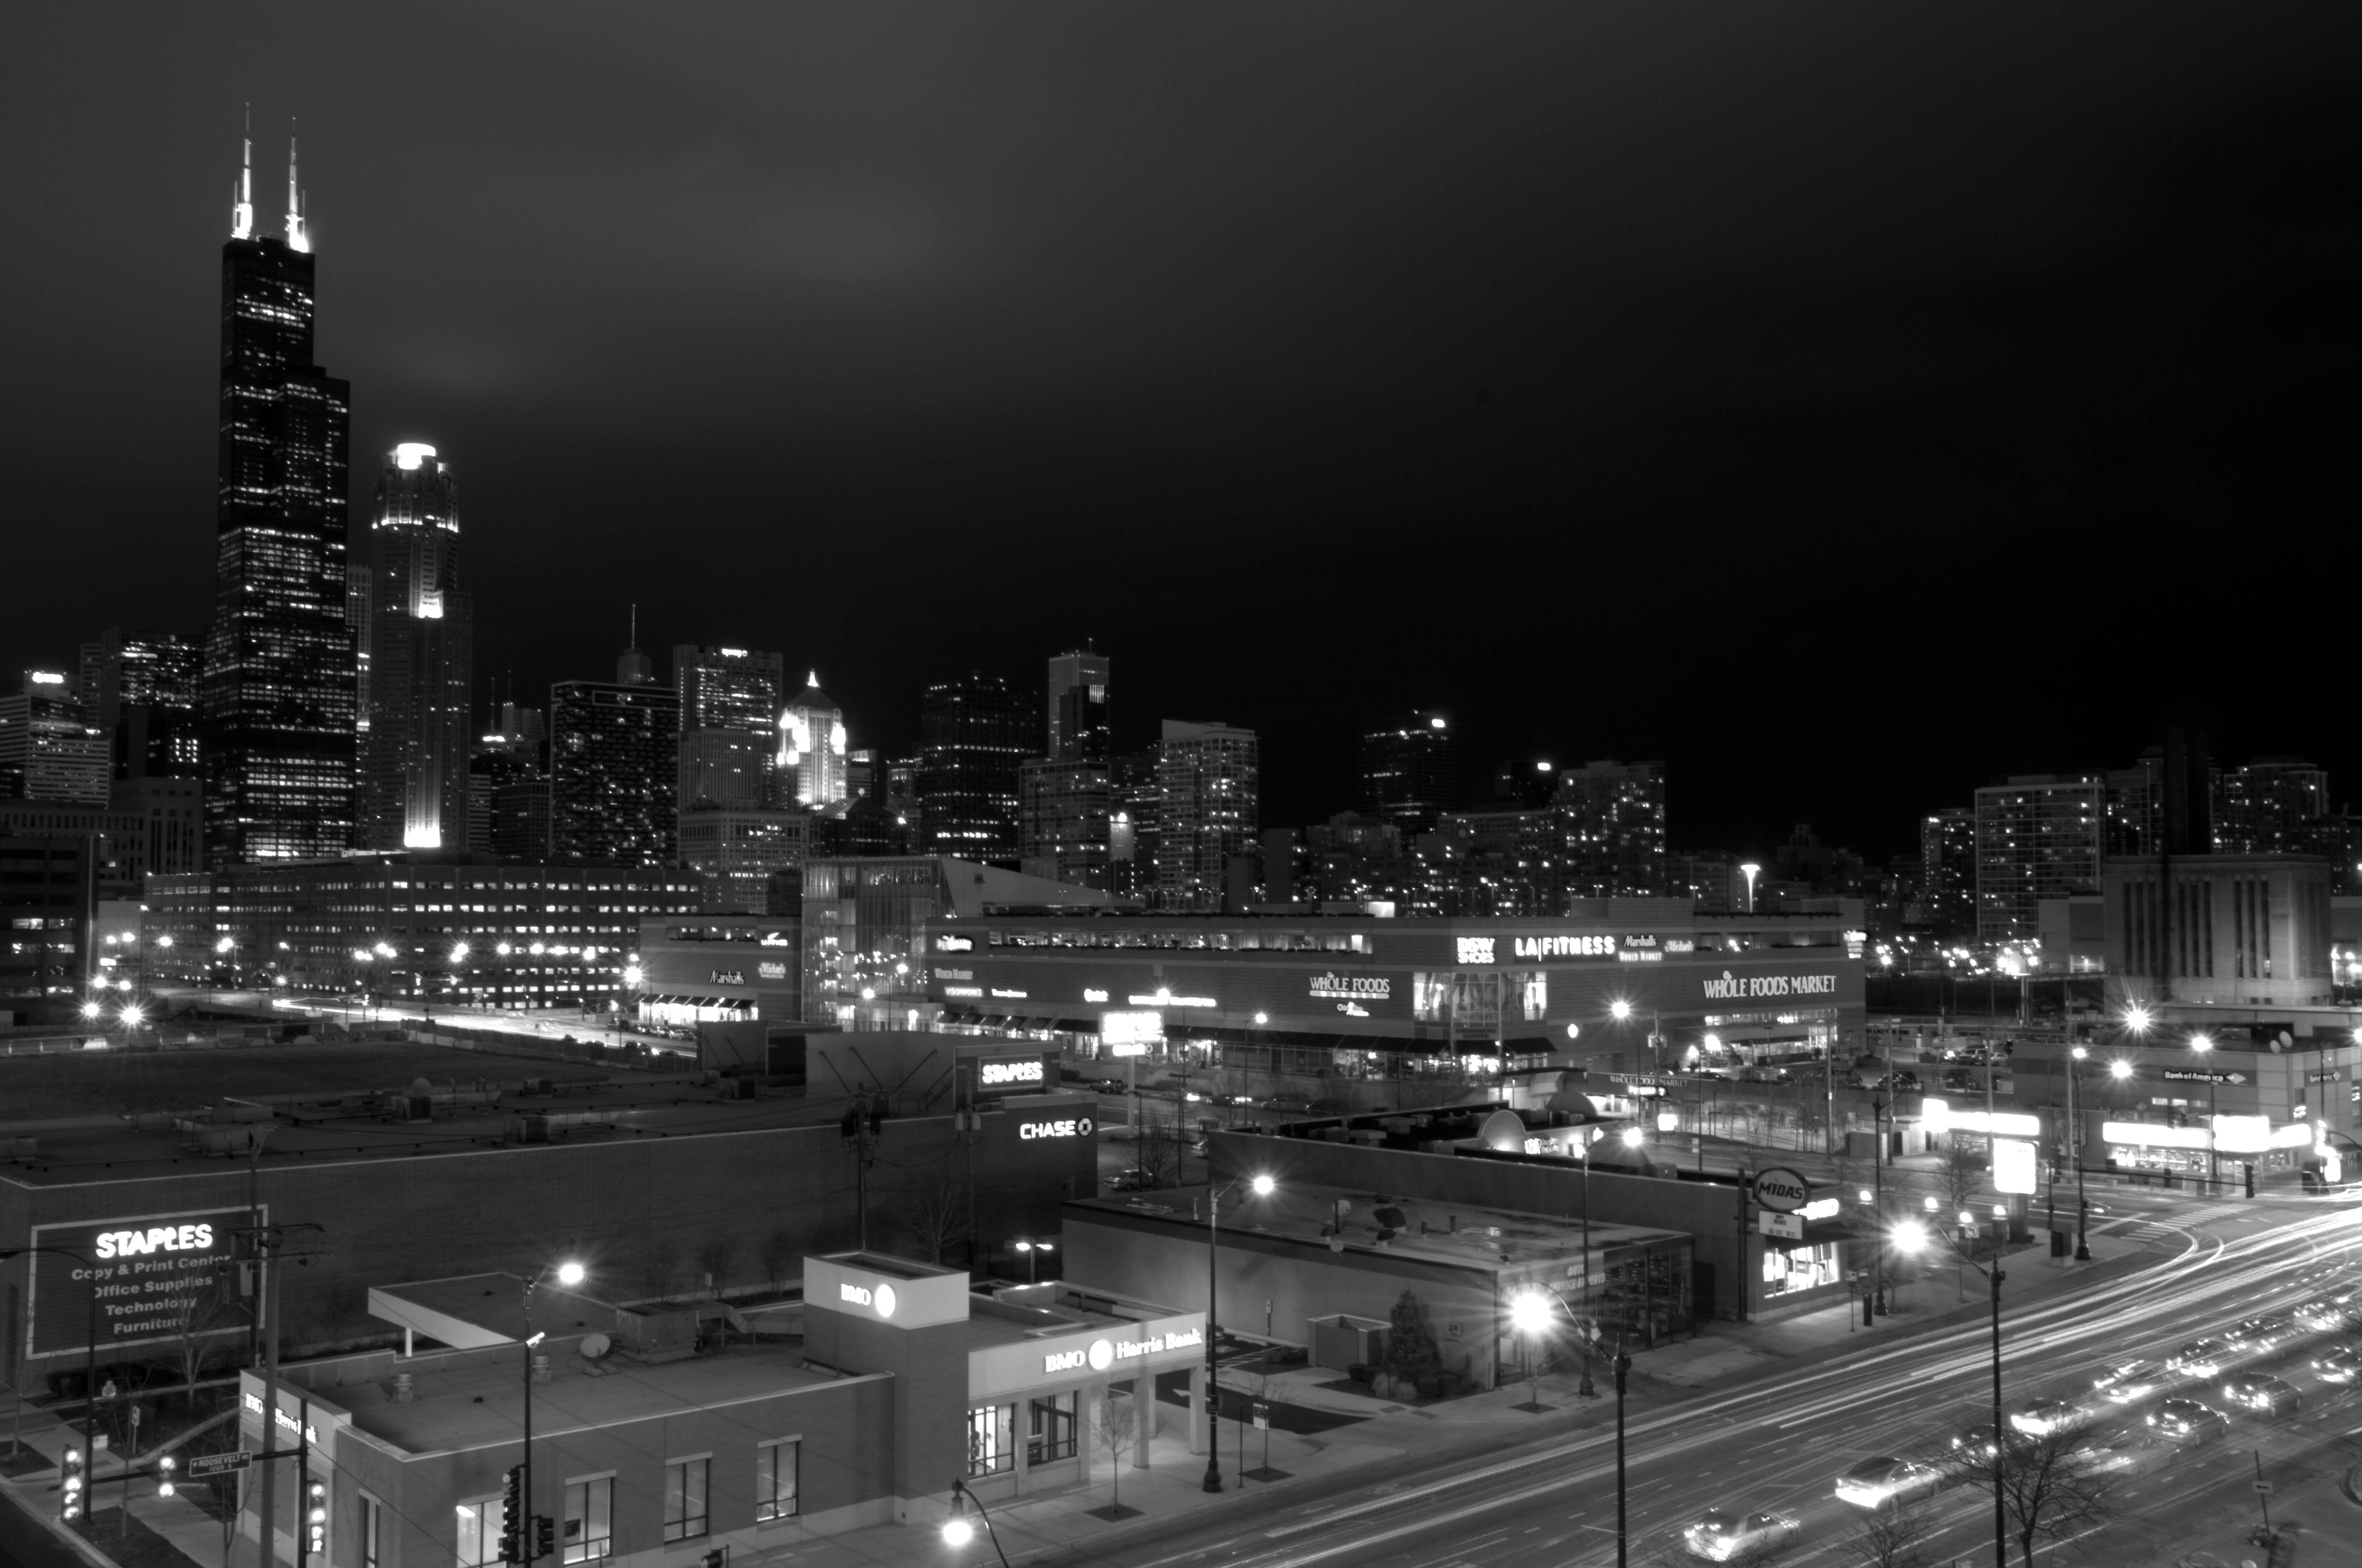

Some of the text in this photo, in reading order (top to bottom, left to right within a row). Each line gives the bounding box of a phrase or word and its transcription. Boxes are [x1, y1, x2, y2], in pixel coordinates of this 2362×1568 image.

[1457, 937, 1495, 952] DSW
[1516, 936, 1615, 956] LA FITNESS
[1624, 935, 1656, 947] Marshalls
[1458, 952, 1494, 963] SHOES
[710, 970, 744, 985] Marshalls
[1309, 977, 1390, 992] WHOLE FOODS
[1703, 975, 1837, 999] WHOLE FOODS MARKET
[982, 1062, 1043, 1084] STAPLES
[1610, 1075, 1634, 1084] WHOLE
[1635, 1077, 1659, 1085] FOOD
[2165, 1070, 2183, 1079] Bank
[1020, 1120, 1075, 1139] CHASE
[1759, 1181, 1803, 1200] MIDAS
[96, 1224, 213, 1258] STAPLES
[72, 1266, 113, 1280] Copy
[117, 1264, 130, 1276] &
[135, 1259, 173, 1273] Print
[144, 1276, 213, 1292] Supplies
[841, 1283, 871, 1306] BMO
[106, 1297, 197, 1316] Technology
[1045, 1328, 1202, 1372] BMO Harris Bank
[198, 1455, 241, 1467] ROOSEVELT
